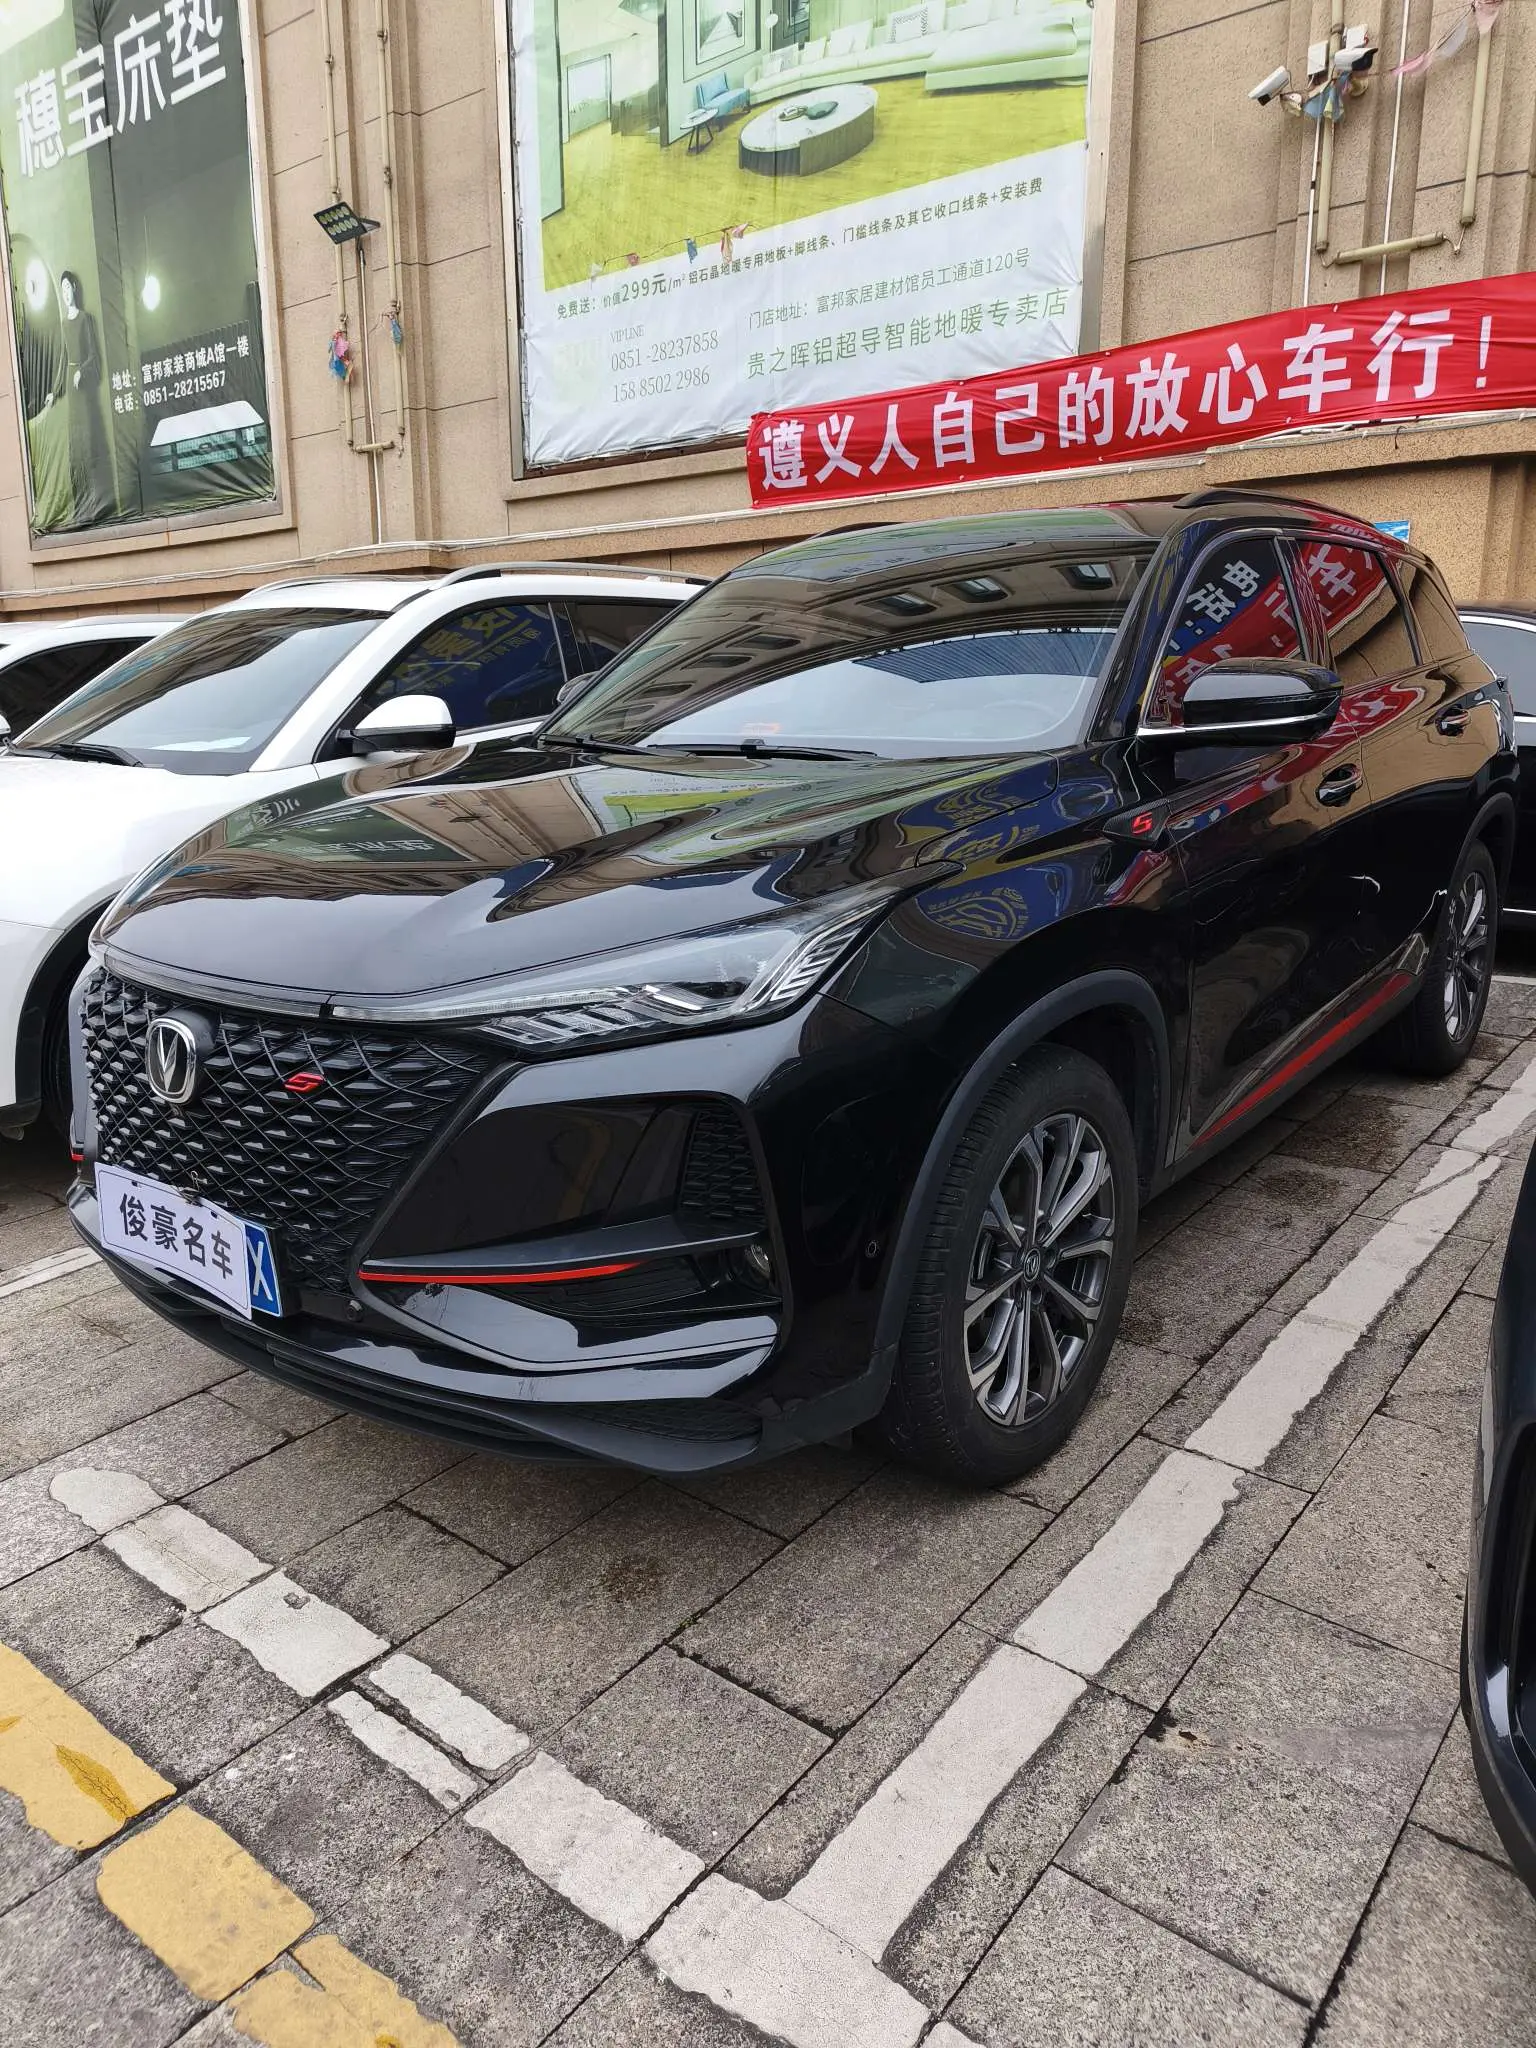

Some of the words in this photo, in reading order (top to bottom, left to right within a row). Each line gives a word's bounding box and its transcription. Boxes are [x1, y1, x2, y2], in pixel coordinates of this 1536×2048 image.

[14, 0, 226, 177] 穗宝床垫
[757, 308, 1490, 491] 遵义人自己的放心车行！
[119, 1192, 234, 1281] 俊豪名车
